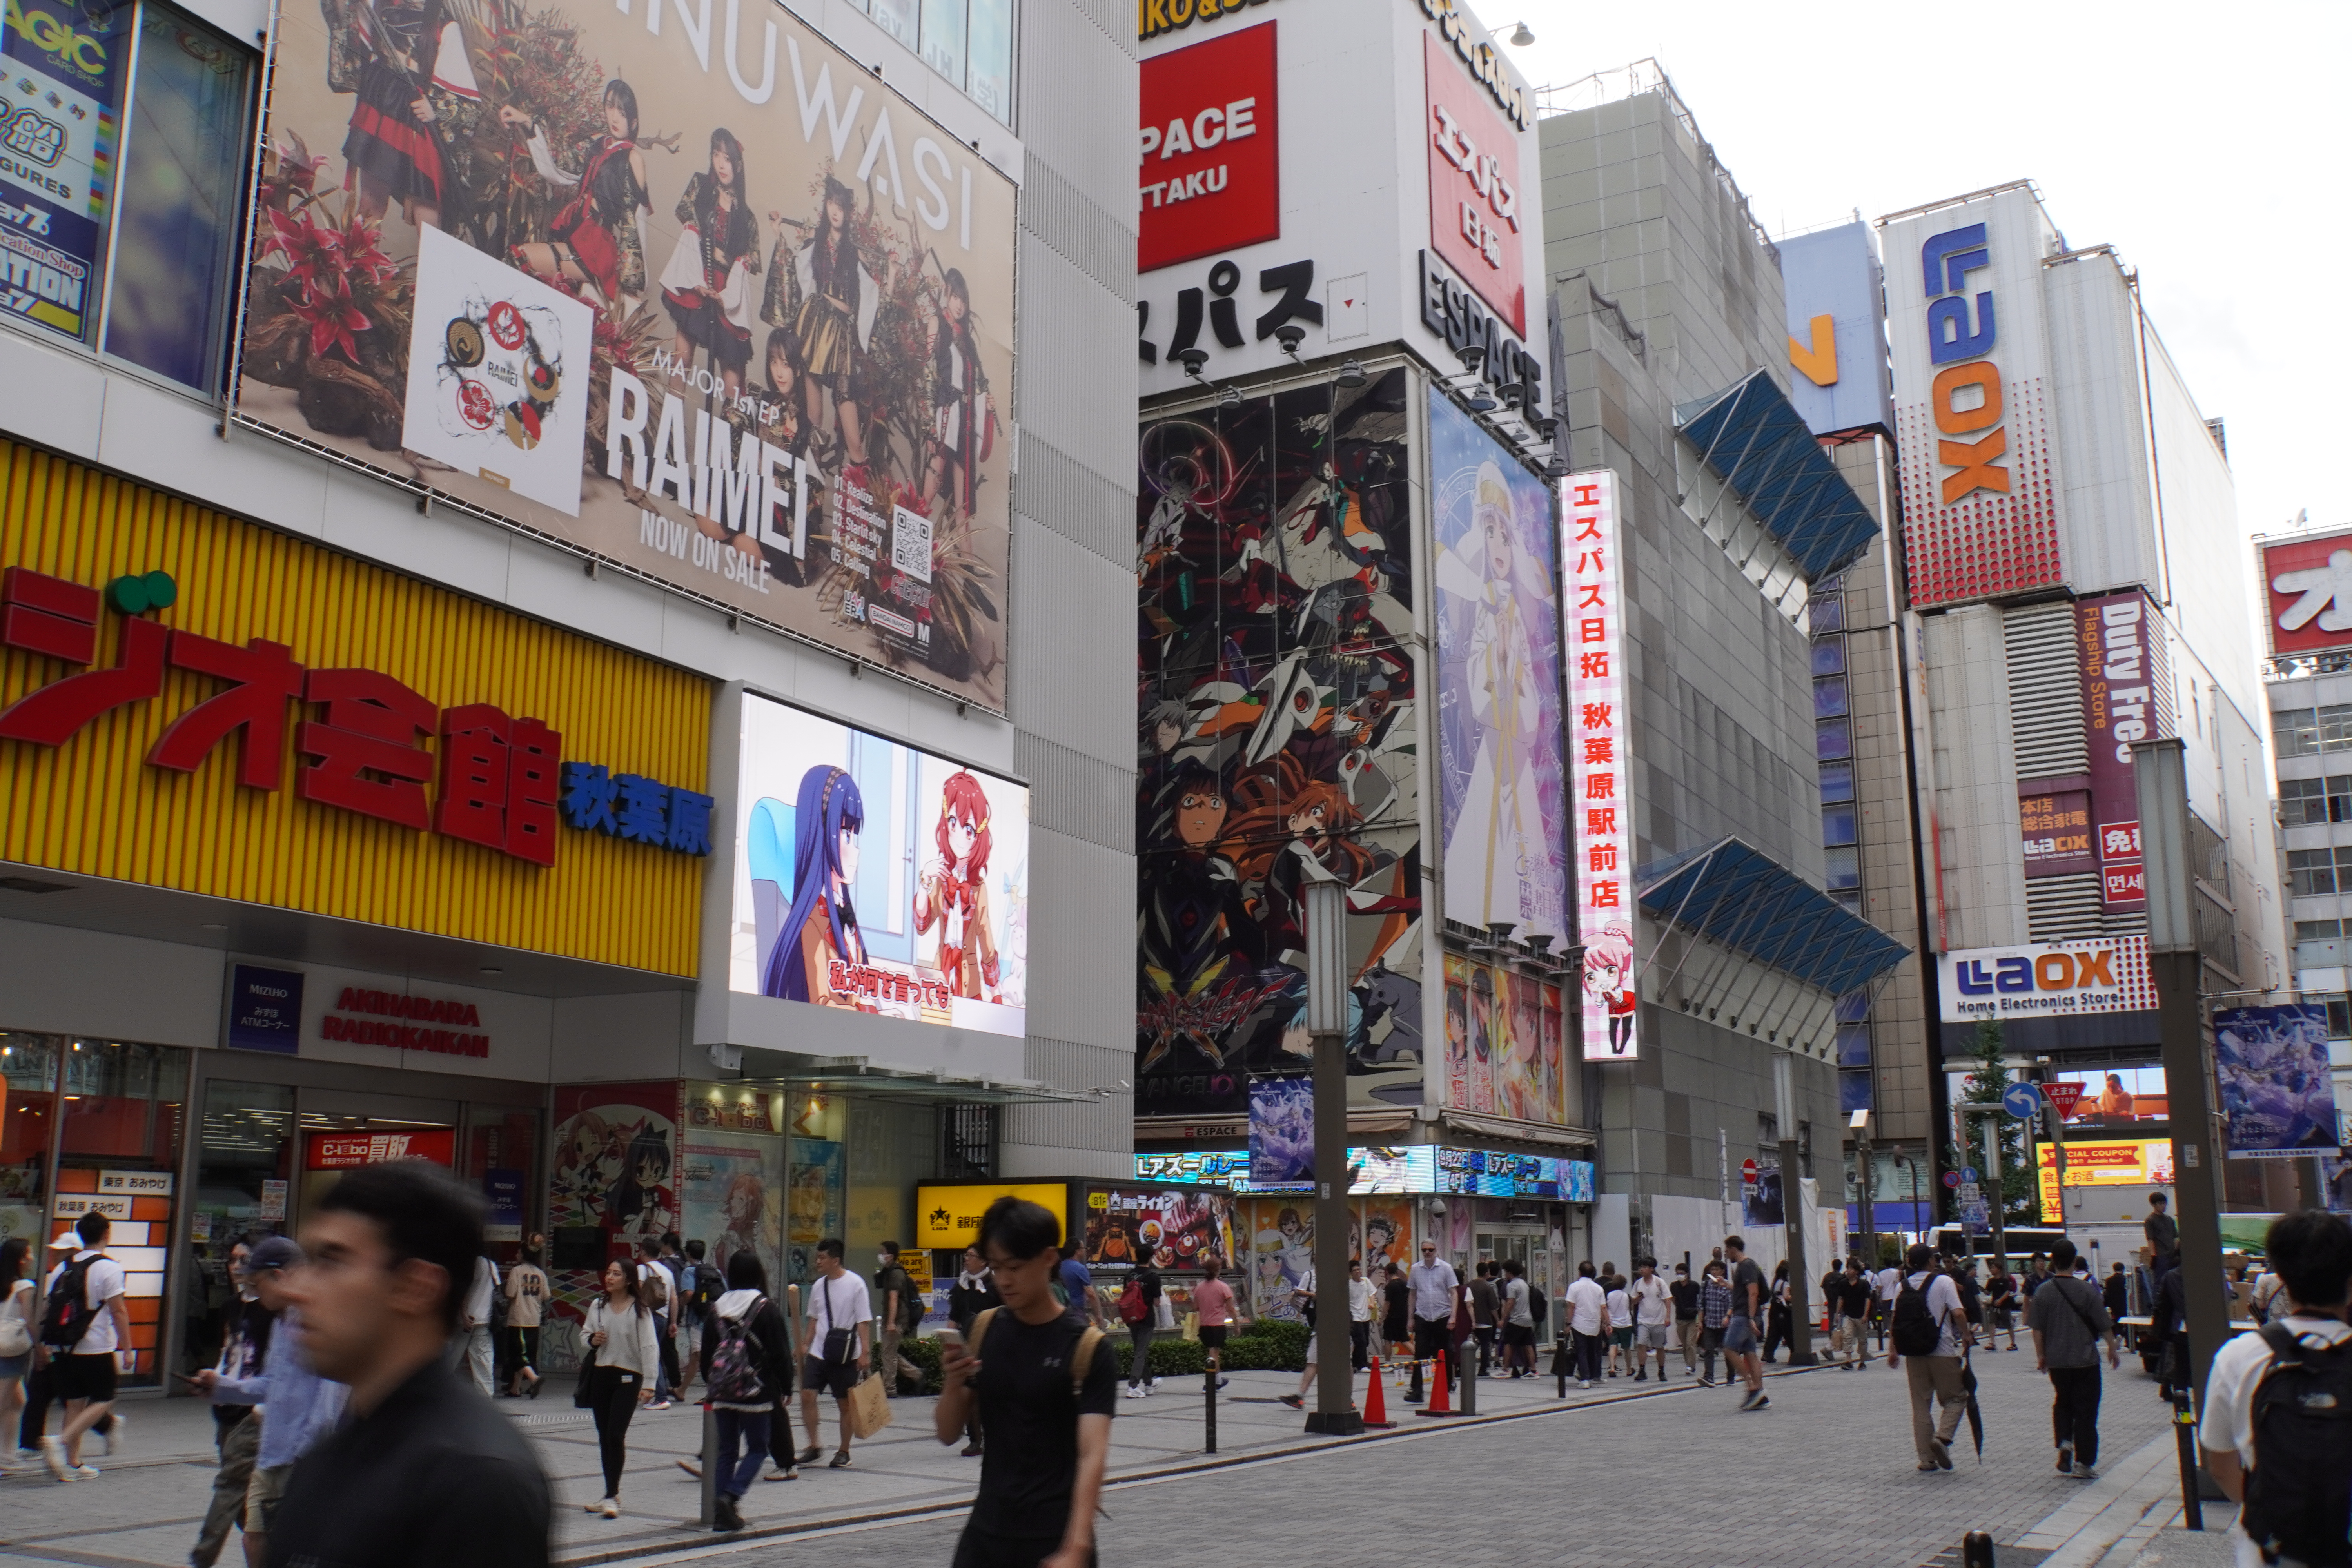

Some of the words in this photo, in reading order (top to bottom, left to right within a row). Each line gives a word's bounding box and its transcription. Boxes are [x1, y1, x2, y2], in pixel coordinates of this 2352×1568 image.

[615, 0, 971, 251] NUWASI
[1433, 103, 1520, 233] エスパス
[49, 251, 84, 277] Shop
[1419, 249, 1543, 425] ESPACE
[488, 361, 519, 388] RAIMEI
[651, 346, 725, 401] MAJOR
[758, 399, 780, 426] EP
[606, 366, 808, 560] RAIMEI
[847, 481, 874, 506] Realize
[846, 498, 887, 530] Destination
[845, 535, 877, 561] Celestial
[869, 528, 882, 548] sky
[640, 510, 689, 559] NOW
[692, 532, 720, 573] ON
[724, 538, 771, 595] SALE
[844, 553, 870, 580] Calling
[1573, 484, 1610, 679] エスパス日拓
[2273, 547, 2352, 631] オ
[2082, 607, 2104, 677] Flagship
[2102, 601, 2142, 680] Duty
[0, 566, 563, 868] ジオ会館
[559, 760, 714, 857] 秋葉原
[2089, 682, 2107, 729] Store
[1582, 702, 1619, 908] 秋葉原駅前店
[2021, 798, 2053, 815] 本店
[2021, 810, 2088, 831] 総合家電
[2107, 873, 2145, 893] 면세
[249, 984, 288, 998] MIZUHO
[829, 961, 949, 1009] 私が何を言っても
[254, 1007, 279, 1018] みずほ
[336, 987, 481, 1027] AKIHABARA
[1957, 1000, 1996, 1013] Home
[2000, 994, 2076, 1010] Electronics
[2080, 992, 2119, 1004] Store
[240, 1016, 290, 1029] ATMコーナー
[322, 1016, 490, 1058] RADIOKAIKAN
[2050, 1086, 2078, 1096] 止まれ
[1197, 1126, 1237, 1135] ESPACE
[103, 1177, 124, 1187] 東京
[129, 1178, 167, 1189] おみやげ
[58, 1201, 86, 1212] 秋葉原
[90, 1202, 124, 1213] おみやげ
[1094, 1196, 1107, 1207] B1F
